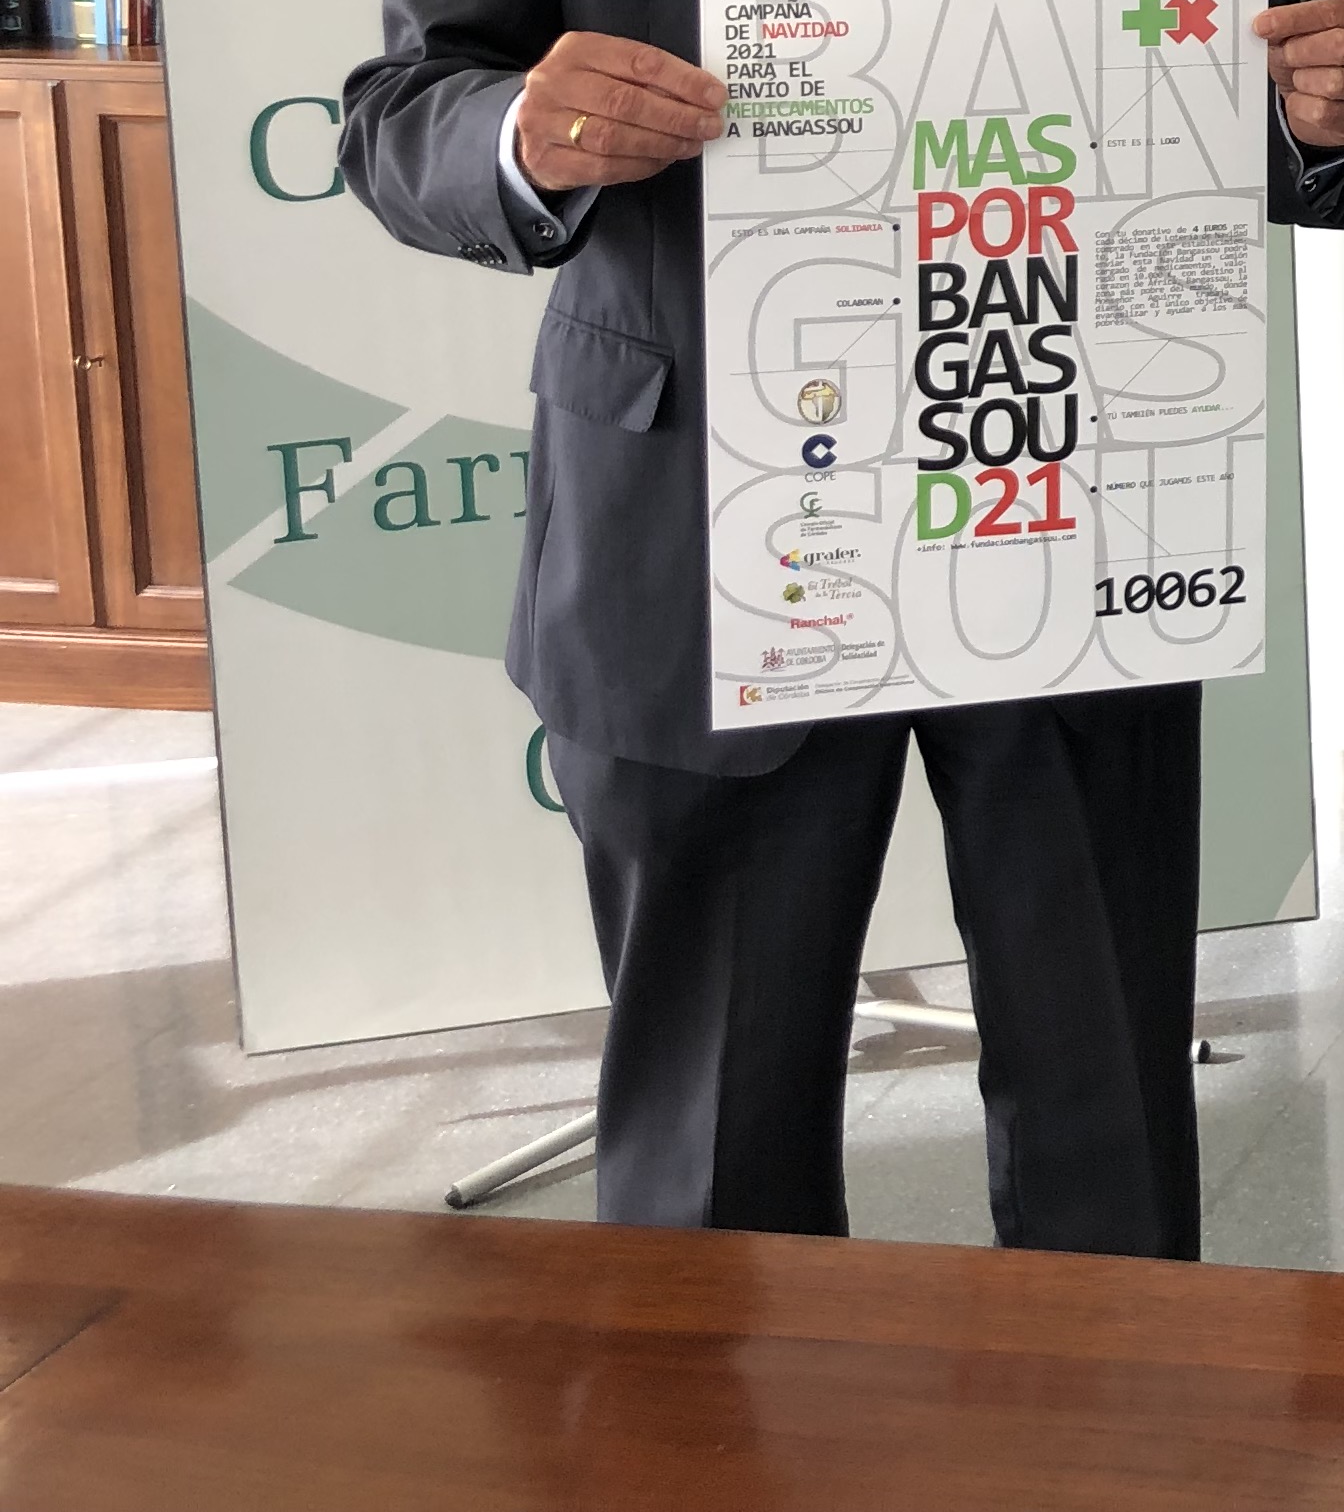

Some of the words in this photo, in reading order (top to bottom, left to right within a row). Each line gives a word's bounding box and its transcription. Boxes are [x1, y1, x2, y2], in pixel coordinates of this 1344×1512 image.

[725, 23, 749, 40] DE
[762, 21, 849, 39] NAVIDAD
[726, 42, 776, 59] 2021
[726, 62, 776, 79] PARA
[789, 61, 812, 77] EL
[727, 77, 789, 99] ENVÍO
[800, 80, 824, 96] DE
[726, 98, 874, 119] MEDICAMENTOS
[727, 122, 740, 138] A
[752, 117, 862, 137] BANGASSOU
[912, 113, 1076, 190] MAS
[917, 183, 1079, 261] POR
[836, 297, 883, 308] COLABORAN
[918, 254, 1078, 331] BAN
[914, 323, 1077, 403] GAS
[917, 392, 1078, 472] SOU
[805, 470, 836, 482] COPE
[916, 461, 1076, 542] D21
[1095, 564, 1246, 617] 10062
